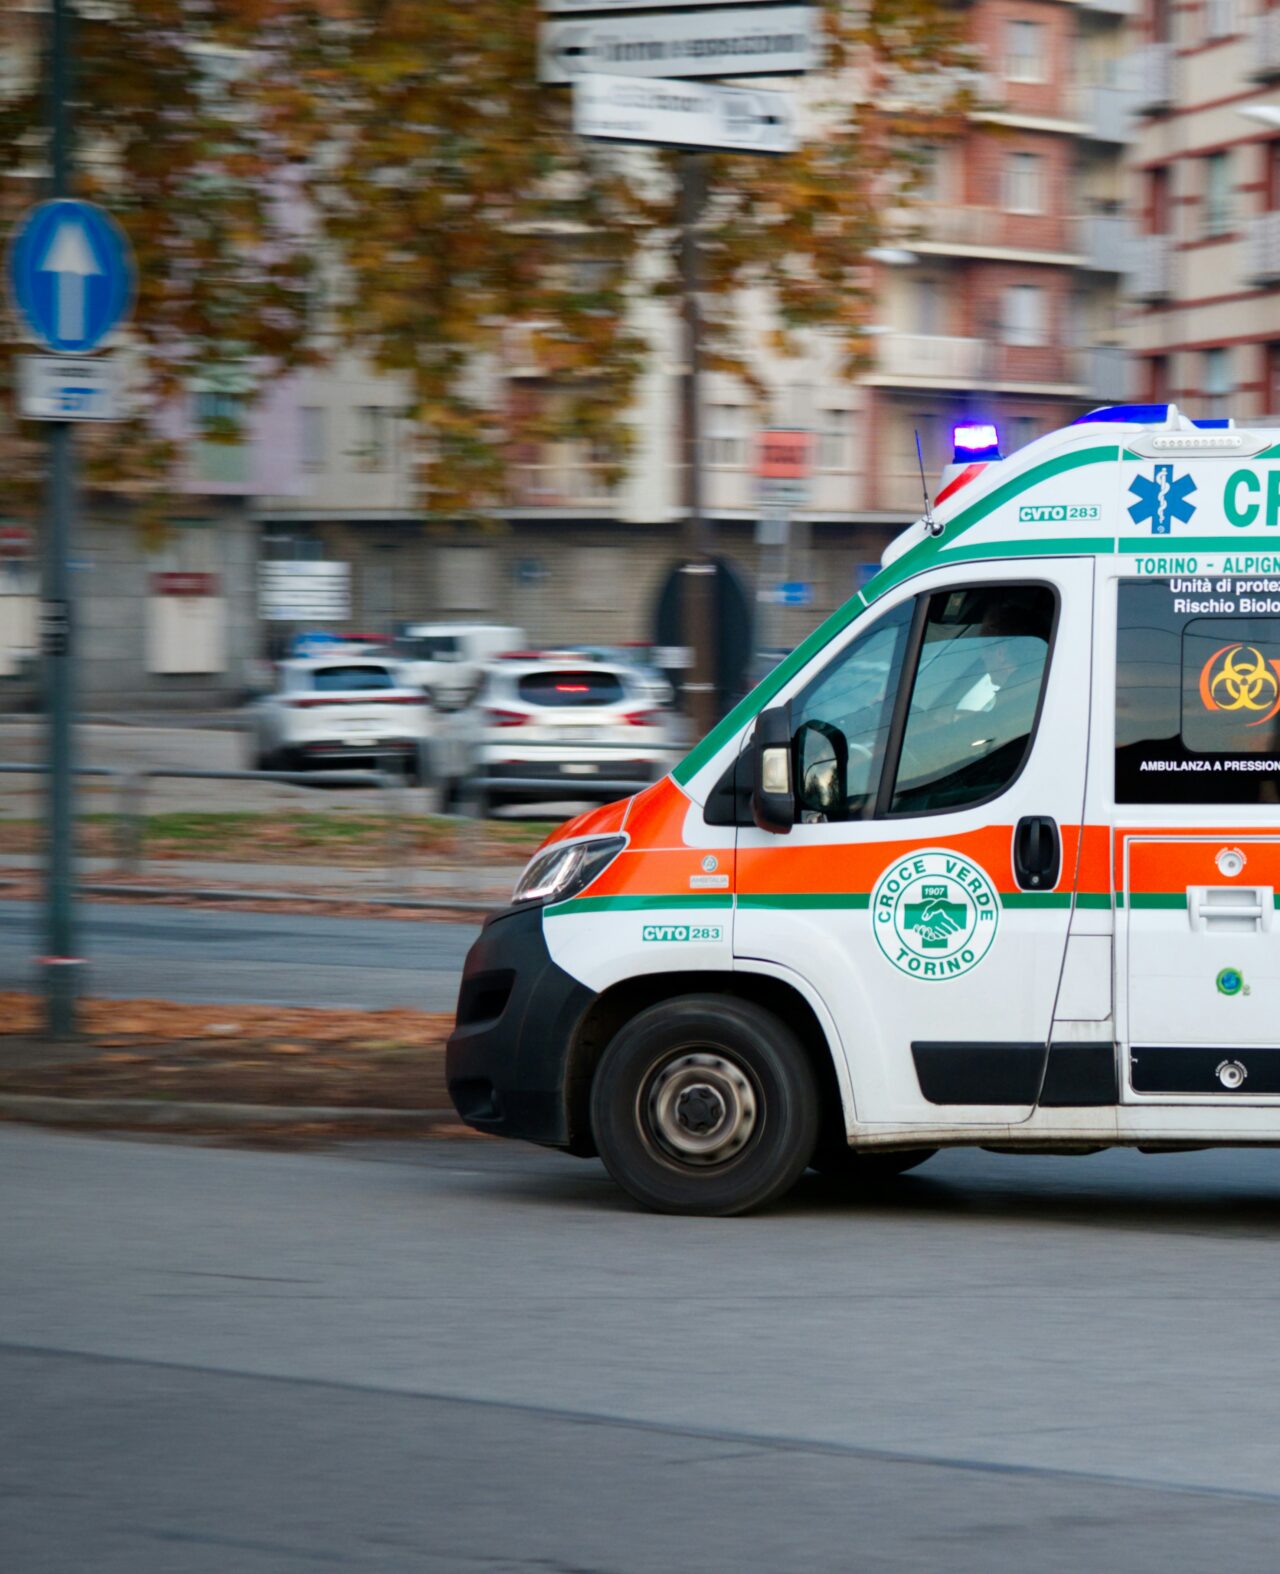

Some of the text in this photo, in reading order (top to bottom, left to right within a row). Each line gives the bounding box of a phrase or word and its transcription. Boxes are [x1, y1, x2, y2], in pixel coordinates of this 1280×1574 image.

[1020, 507, 1098, 520] CVTO 283
[1135, 557, 1197, 574] TORINO
[1169, 578, 1212, 593] Unità
[1215, 578, 1231, 593] di
[1174, 598, 1235, 613] Rischio
[1140, 761, 1212, 772] AMBULANZA
[1213, 761, 1222, 771] A
[878, 859, 994, 924] CROCE VERDE
[923, 886, 946, 897] 1907
[644, 927, 720, 940] CVTO 283
[896, 948, 976, 976] TORINO
